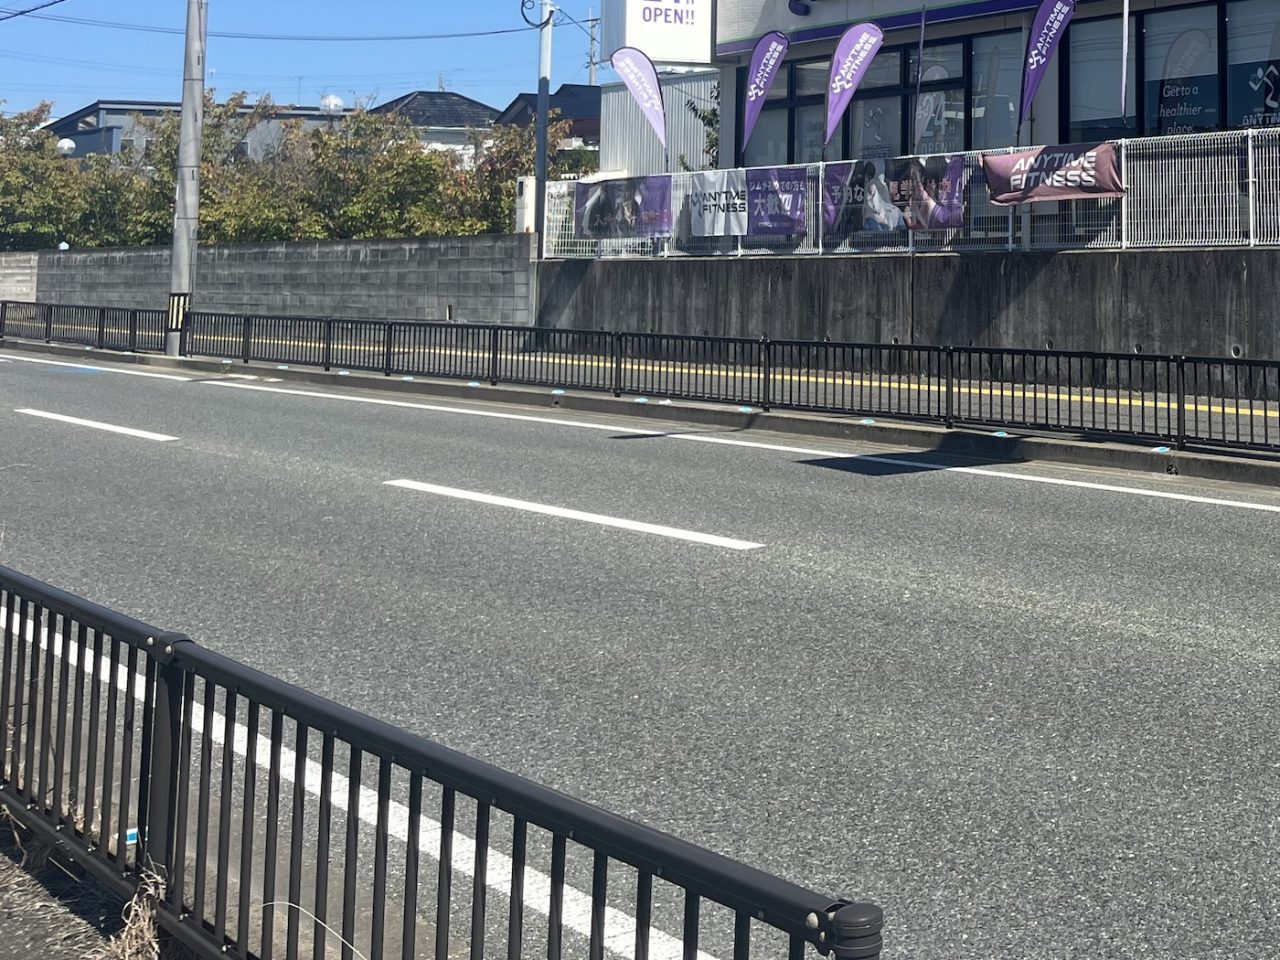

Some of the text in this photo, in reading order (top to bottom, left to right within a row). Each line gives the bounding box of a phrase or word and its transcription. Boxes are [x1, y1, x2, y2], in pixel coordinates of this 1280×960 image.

[642, 6, 695, 25] OPEN!!
[1037, 1, 1064, 50] ANYTIME
[1042, 5, 1070, 55] FITNESS
[756, 41, 779, 84] ANYTIME
[760, 44, 784, 88] FITNESS
[841, 32, 869, 76] ANYTIME
[847, 36, 878, 81] FITNESS
[1163, 85, 1180, 98] Get
[1181, 86, 1191, 96] to
[1160, 103, 1202, 118] healthier
[1012, 151, 1097, 173] ANYTIME
[1010, 171, 1096, 191] FITNESS
[703, 203, 746, 215] FITNESS
